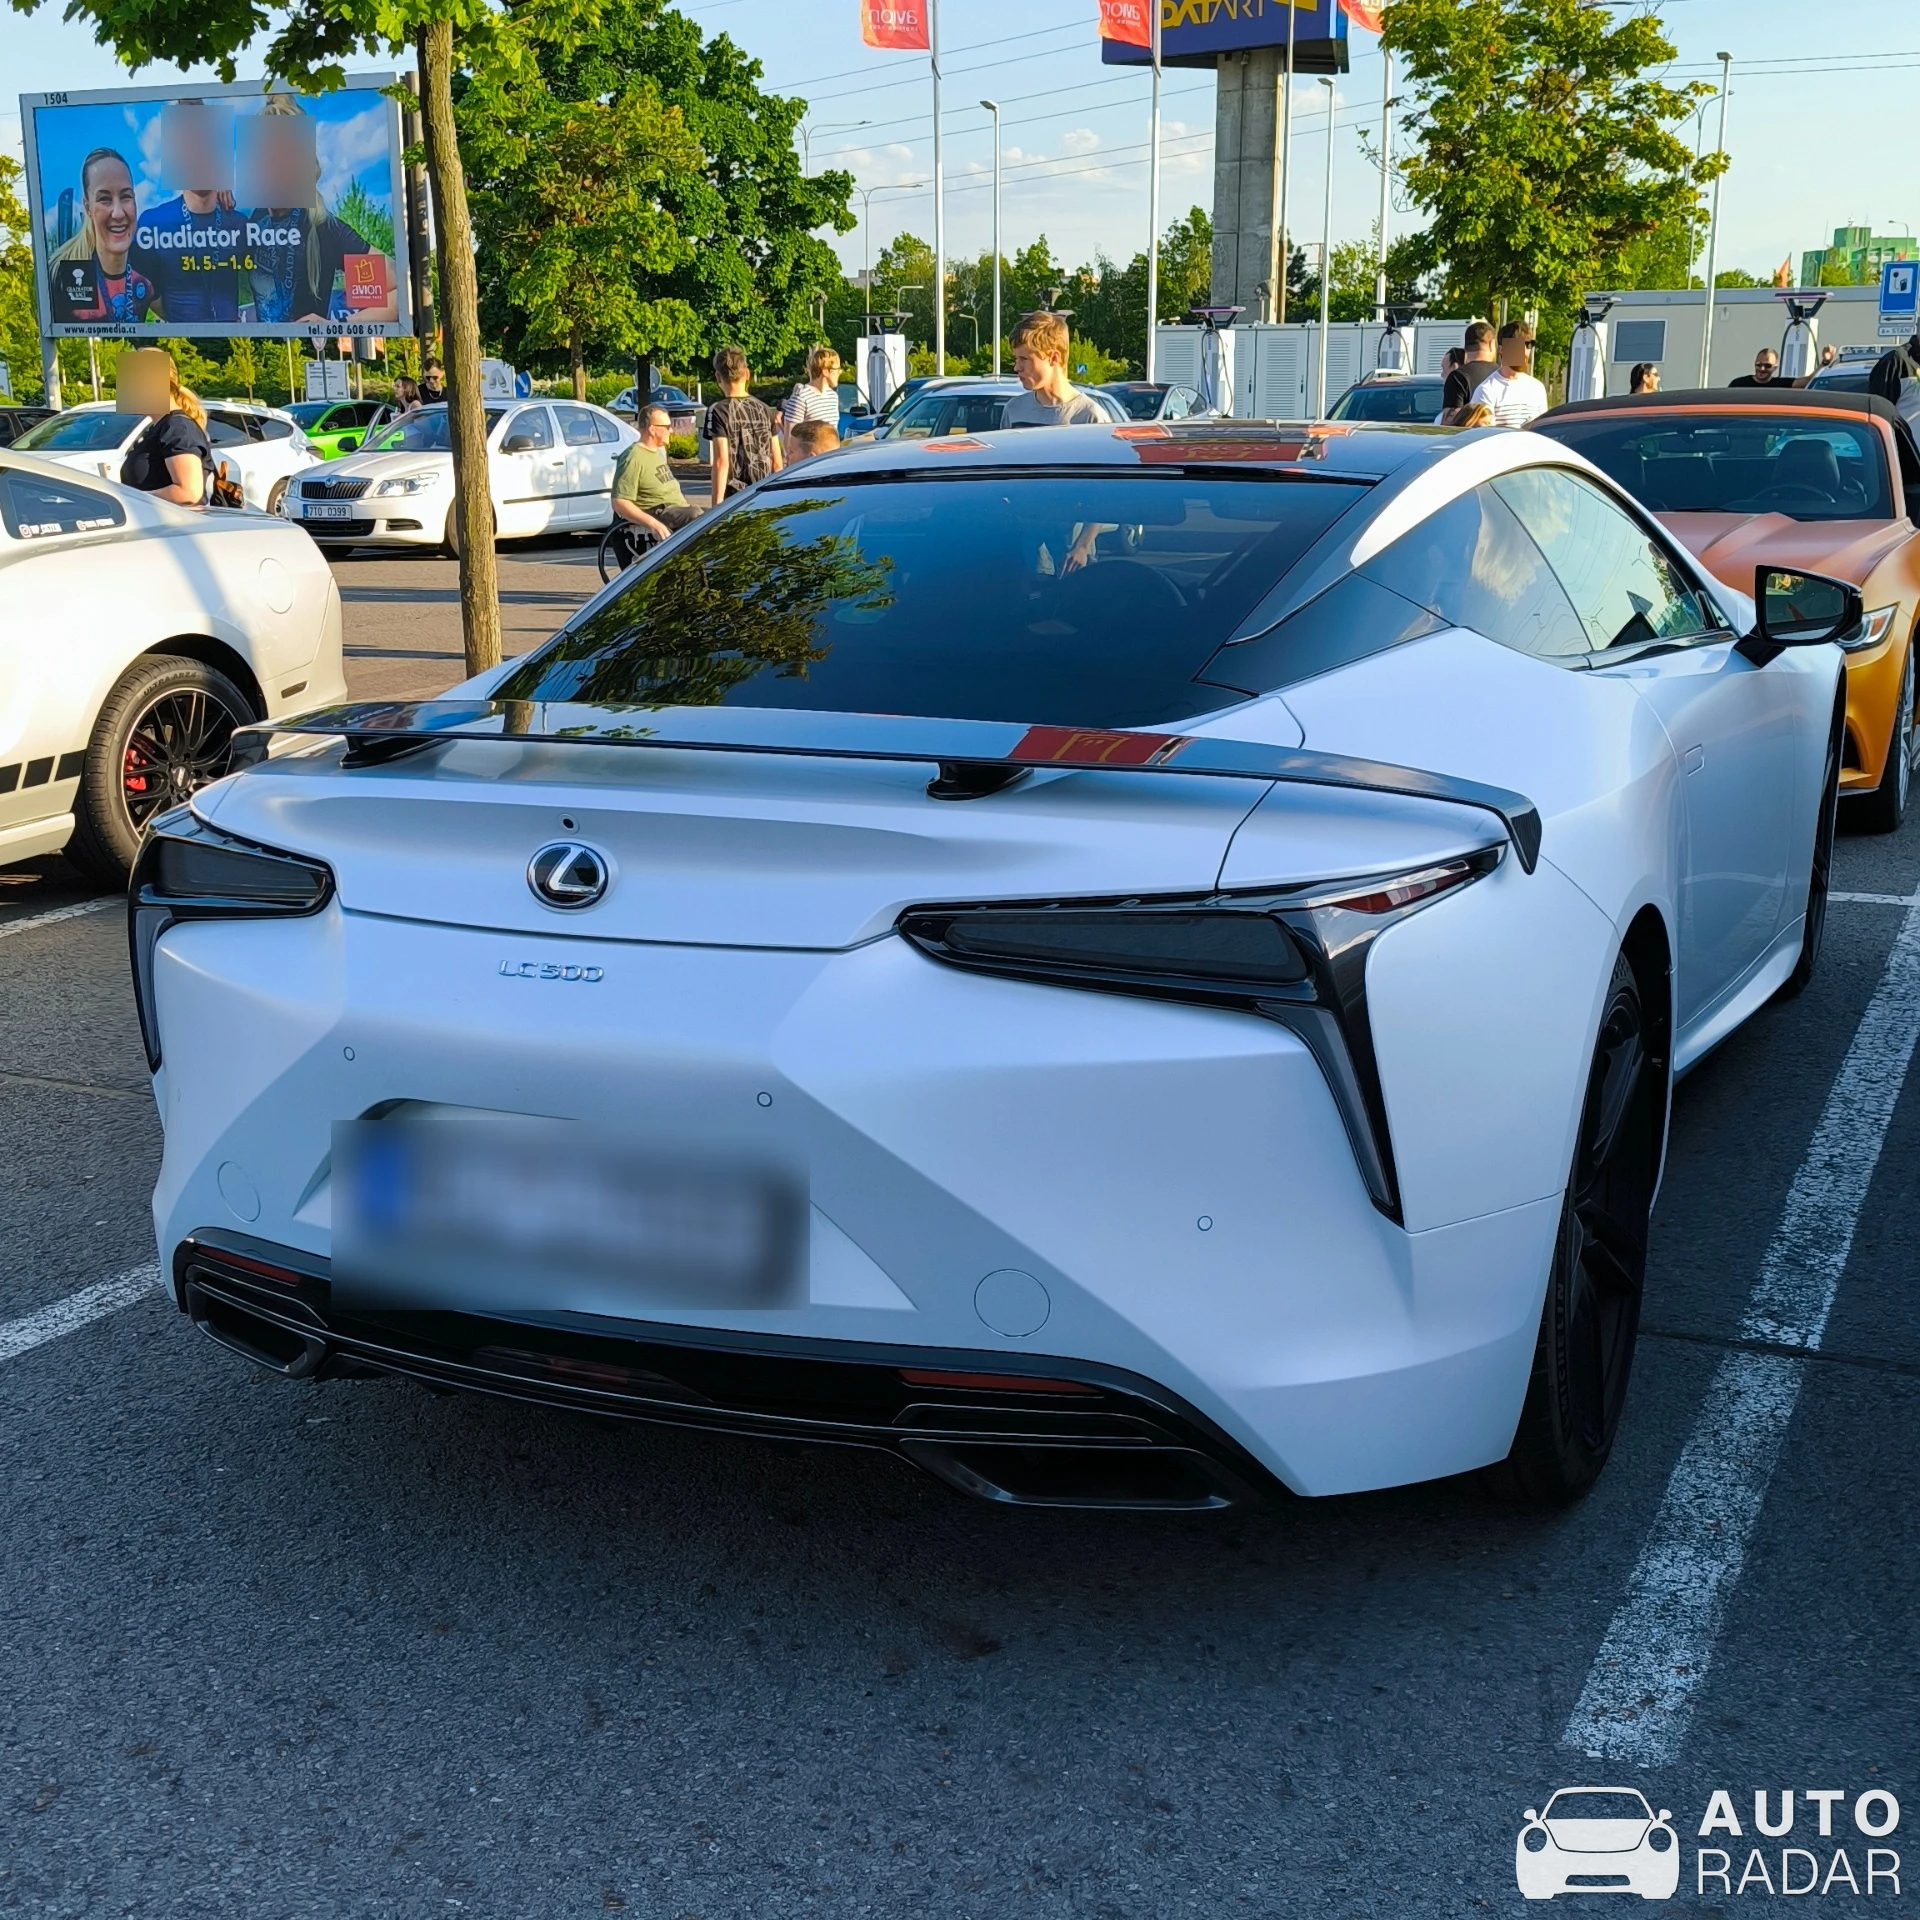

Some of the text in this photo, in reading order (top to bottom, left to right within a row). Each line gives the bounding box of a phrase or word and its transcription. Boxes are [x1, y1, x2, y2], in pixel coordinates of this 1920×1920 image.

[43, 92, 69, 105] 1504
[136, 223, 301, 249] Gladiator Race
[181, 255, 201, 271] 31.
[352, 284, 382, 295] avion
[308, 324, 385, 335] tel. 608 608 617
[327, 507, 347, 517] 0399
